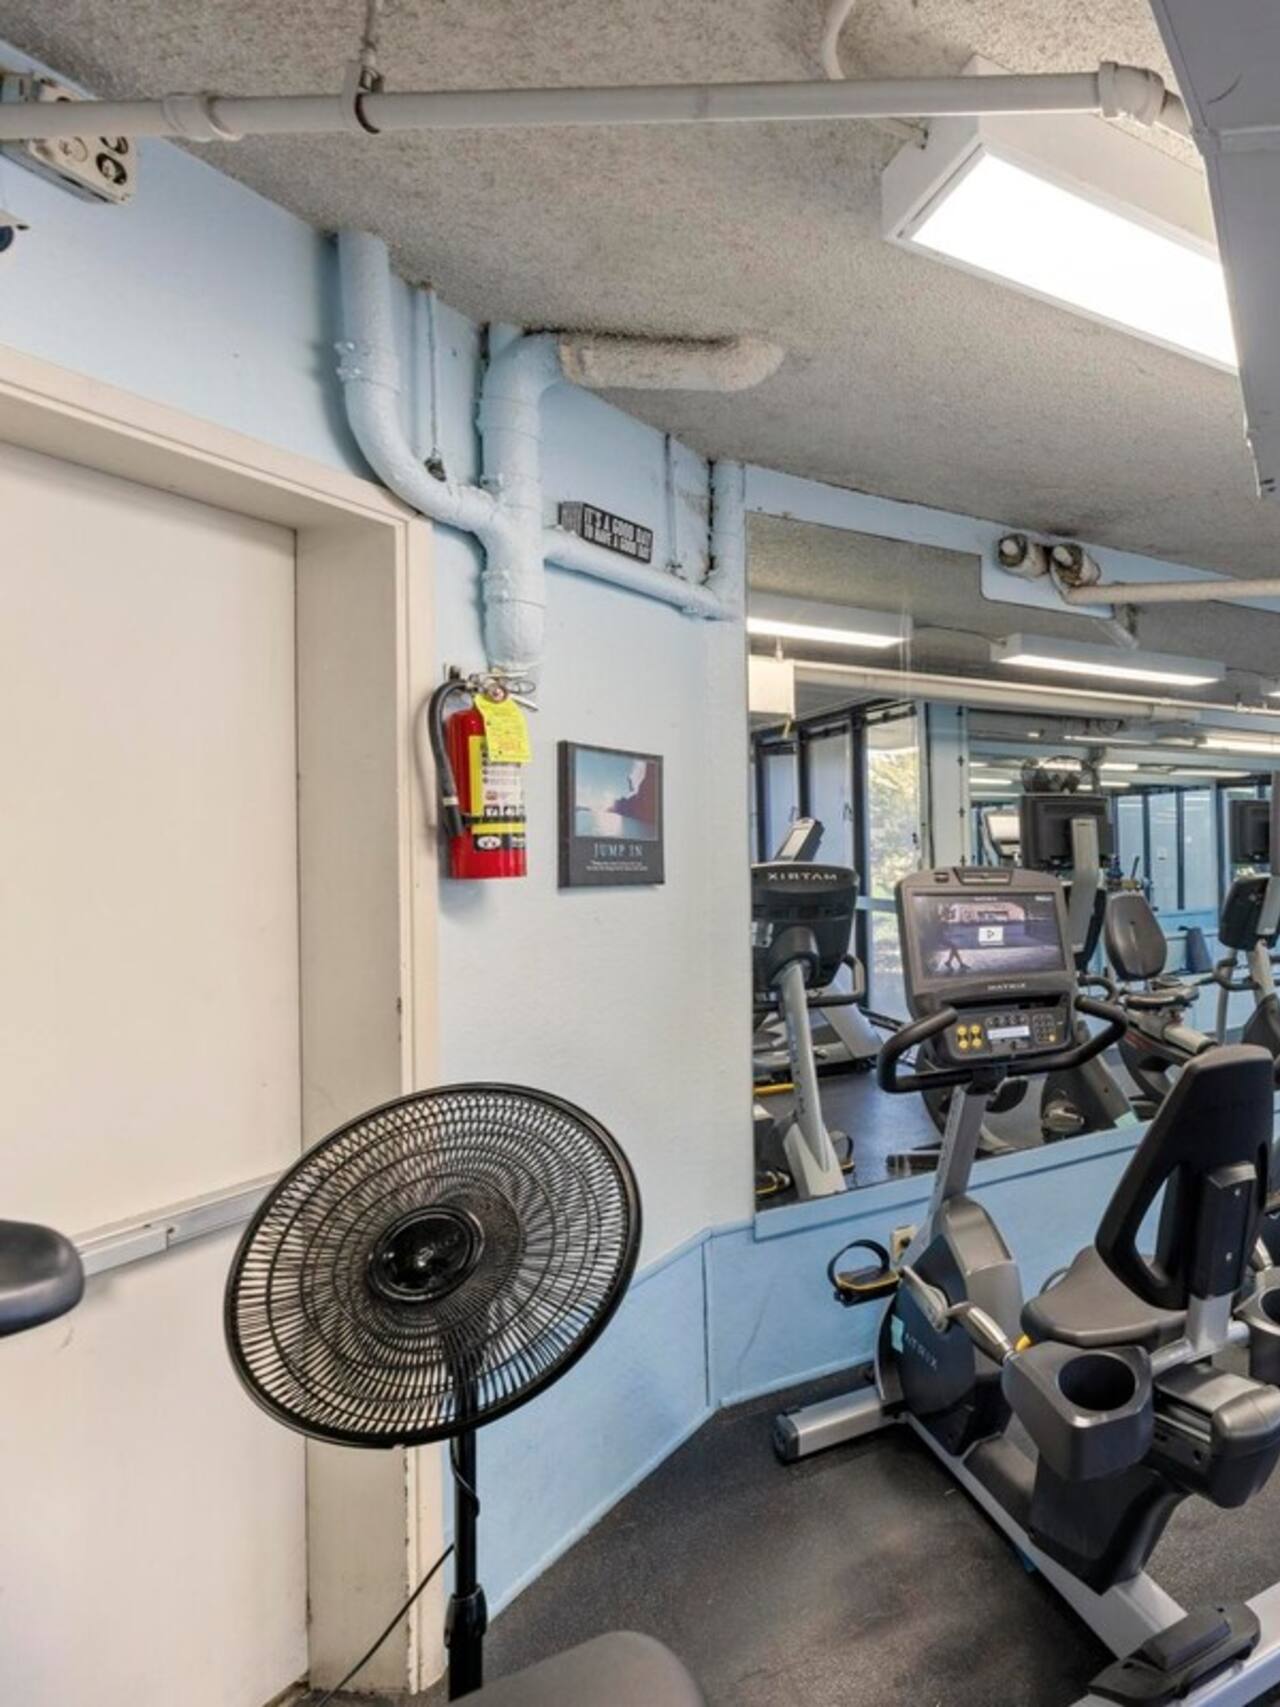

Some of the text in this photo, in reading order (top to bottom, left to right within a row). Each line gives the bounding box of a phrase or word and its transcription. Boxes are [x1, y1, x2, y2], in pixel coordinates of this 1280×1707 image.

[584, 507, 602, 531] IT'S
[603, 515, 611, 531] A
[612, 518, 635, 542] GOOD
[593, 843, 643, 858] JUMP IN
